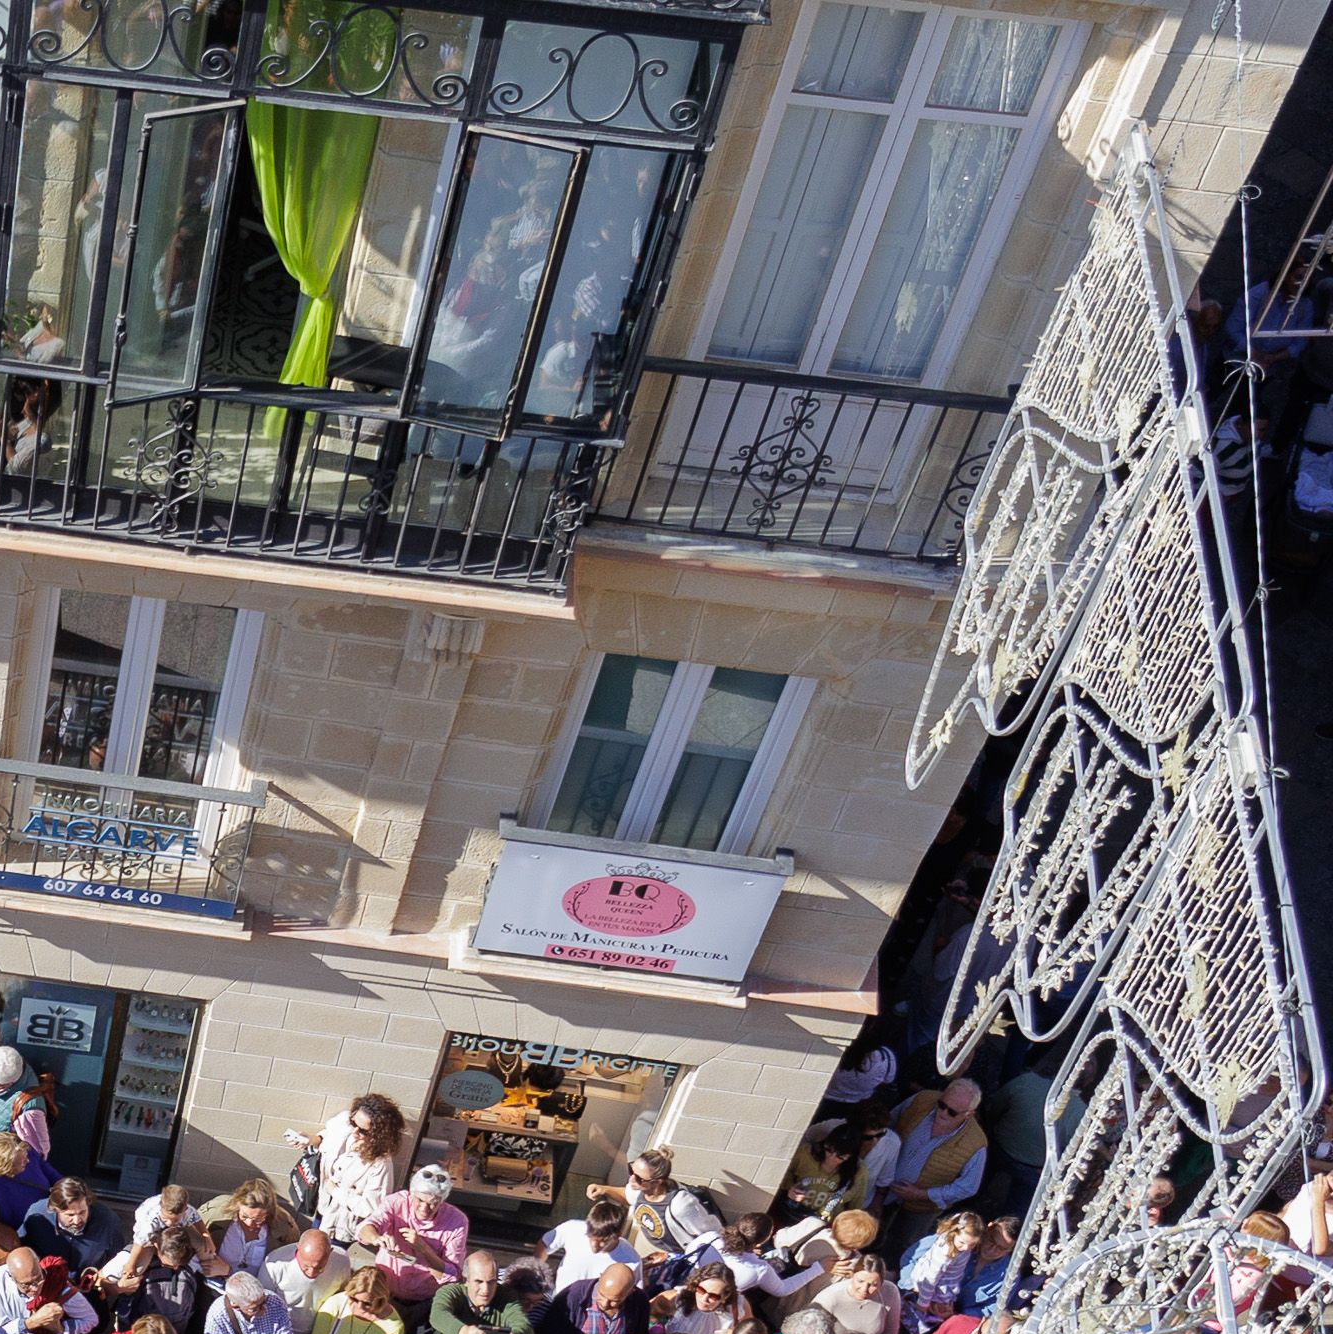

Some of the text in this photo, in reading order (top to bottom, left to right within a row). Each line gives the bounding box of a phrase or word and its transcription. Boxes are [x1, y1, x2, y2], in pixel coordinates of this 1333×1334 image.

[22, 814, 200, 856] ALGARVE
[43, 879, 162, 905] 607 64 64 60
[608, 880, 661, 903] BQ
[610, 907, 643, 916] QUEEN
[602, 923, 620, 931] TUS
[622, 925, 654, 934] MANOS
[568, 947, 670, 970] 651 89 02 46
[449, 1090, 492, 1104] Gratis
